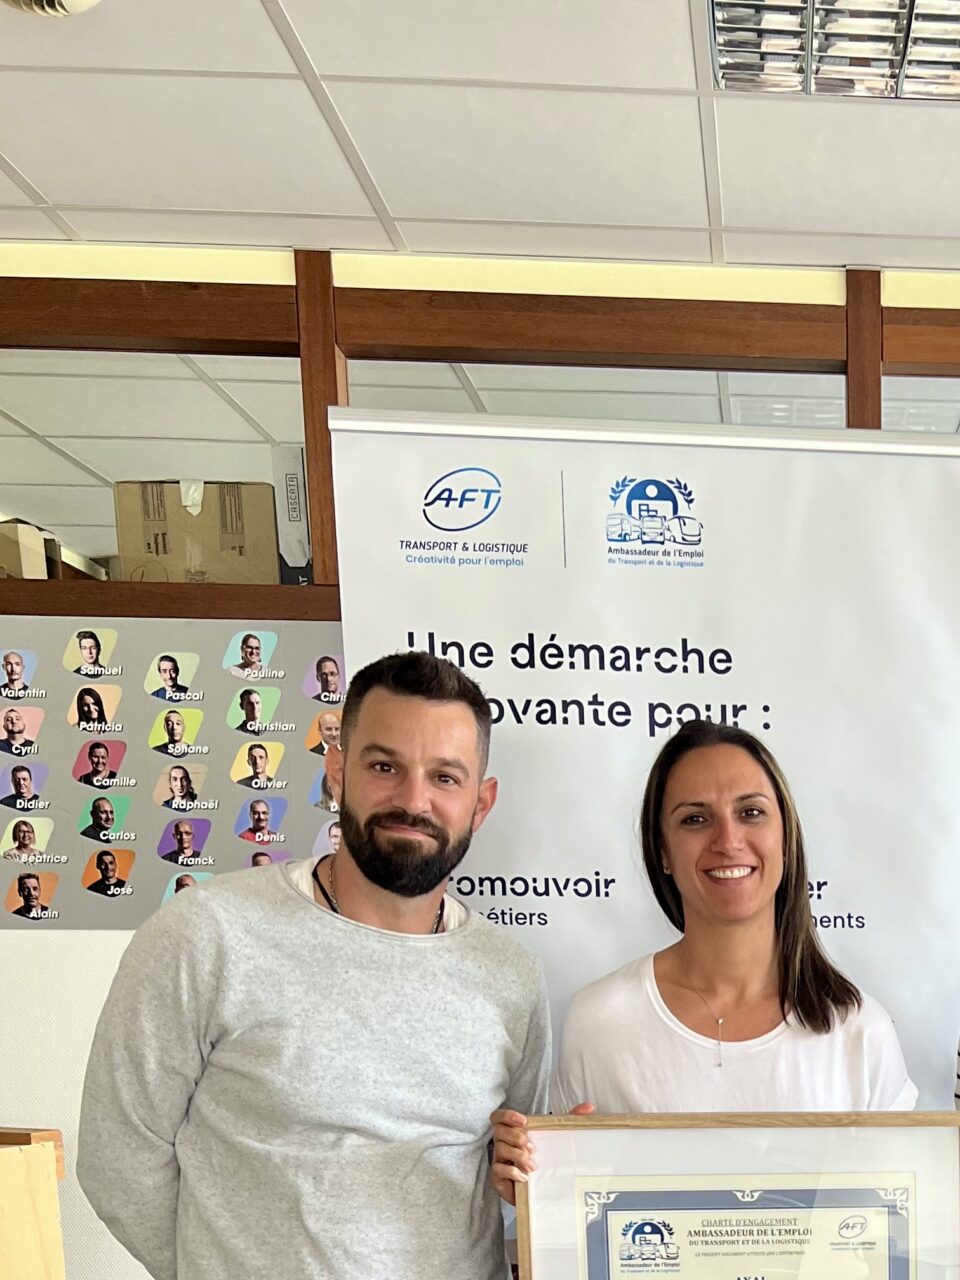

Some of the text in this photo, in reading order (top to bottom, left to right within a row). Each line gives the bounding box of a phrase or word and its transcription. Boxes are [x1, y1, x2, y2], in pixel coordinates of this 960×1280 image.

[425, 487, 501, 509] AFT
[399, 540, 529, 555] TRANSPORT & LOGISTIQUE
[607, 546, 704, 560] Ambassadeur de l'Emploi
[405, 554, 524, 568] Créativité pour l'emploi
[407, 631, 732, 674] Une démarche
[80, 665, 122, 676] Samuel
[244, 667, 285, 679] Pauline
[0, 687, 46, 698] Valentin
[165, 690, 203, 701] Pascal
[489, 694, 631, 728] ovante
[648, 702, 748, 737] pour
[79, 721, 123, 732] Patricia
[246, 721, 296, 732] Christian
[11, 743, 38, 756] Cyril
[93, 776, 136, 787] Camille
[251, 778, 287, 790] Olivier
[16, 798, 50, 810] Didier
[171, 798, 218, 811] Raphaël
[99, 830, 136, 841] Carlos
[255, 832, 286, 843] Denis
[21, 852, 68, 864] Béatrice
[178, 855, 215, 866] Franck
[107, 884, 133, 896] José
[450, 871, 616, 897] omouvoir
[29, 908, 59, 919] Alain
[480, 908, 548, 925] étiers
[701, 1217, 798, 1227] CHARTE D'ENGAGEMENT
[687, 1227, 812, 1238] AMBASSADEUR DE L'EMPLOI
[772, 1238, 811, 1246] LOGISTIQUE
